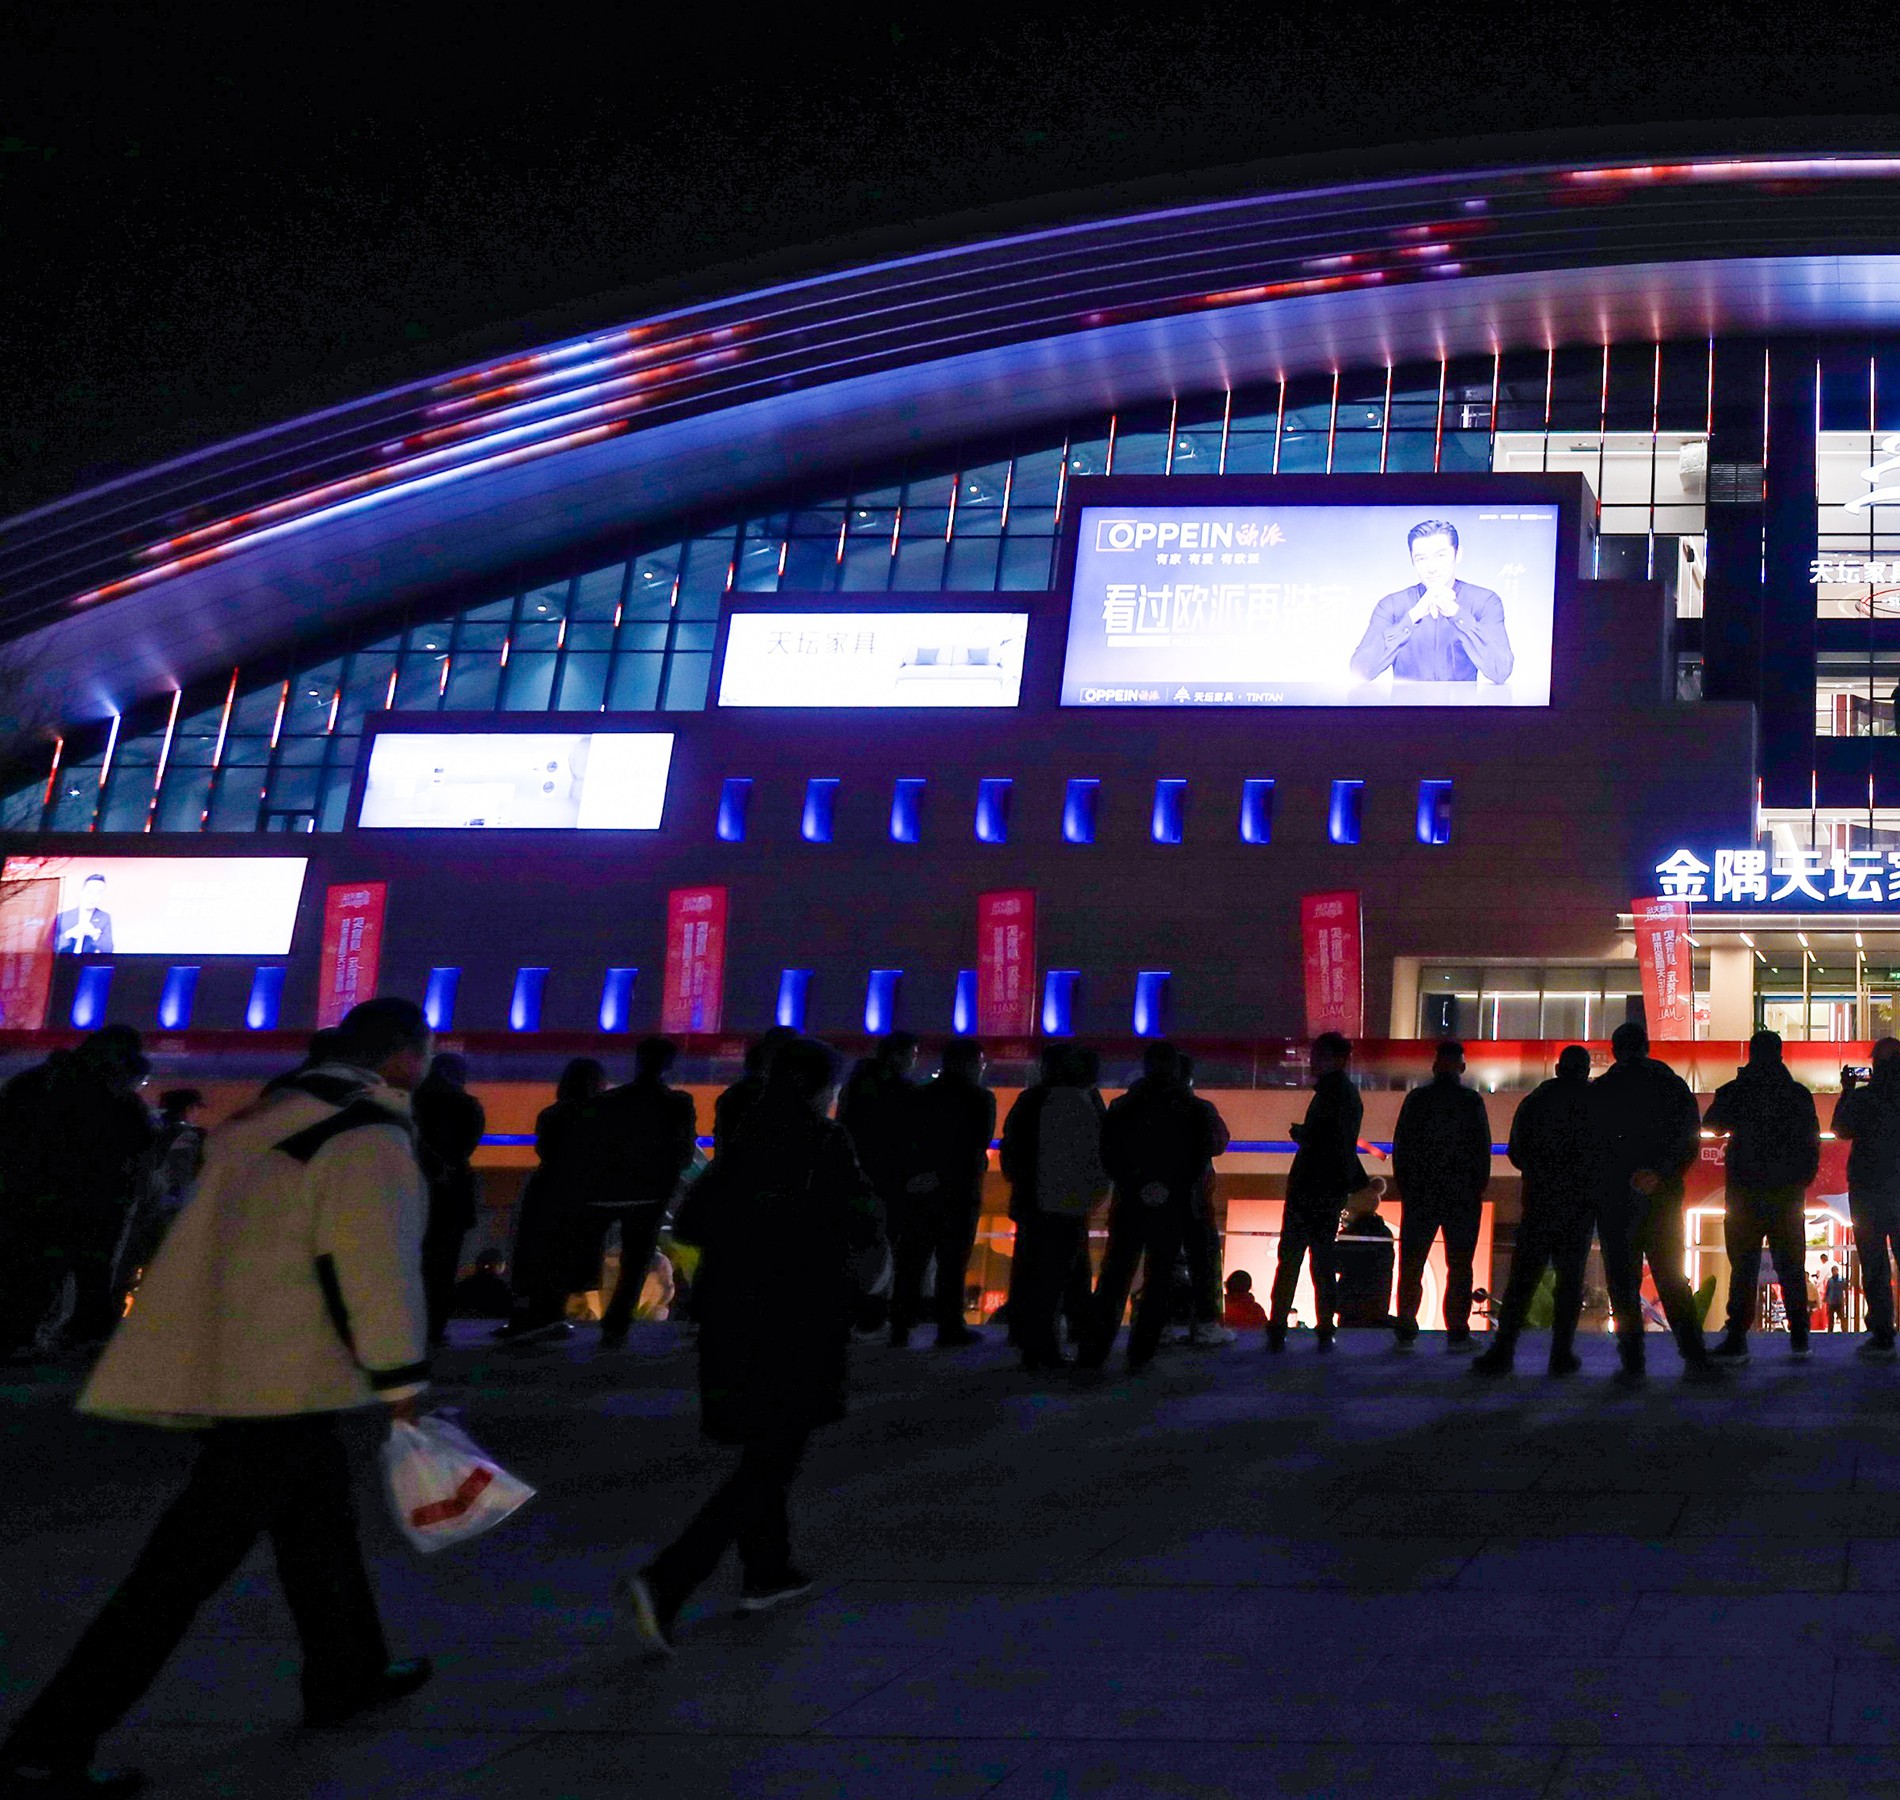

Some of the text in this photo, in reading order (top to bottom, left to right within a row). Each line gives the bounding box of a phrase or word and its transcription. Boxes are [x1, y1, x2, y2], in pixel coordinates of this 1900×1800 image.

[1108, 522, 1233, 549] OPPEIN
[767, 631, 877, 655] 天坛家具
[1085, 689, 1139, 703] OPPEIN
[1246, 692, 1284, 703] TINTAN
